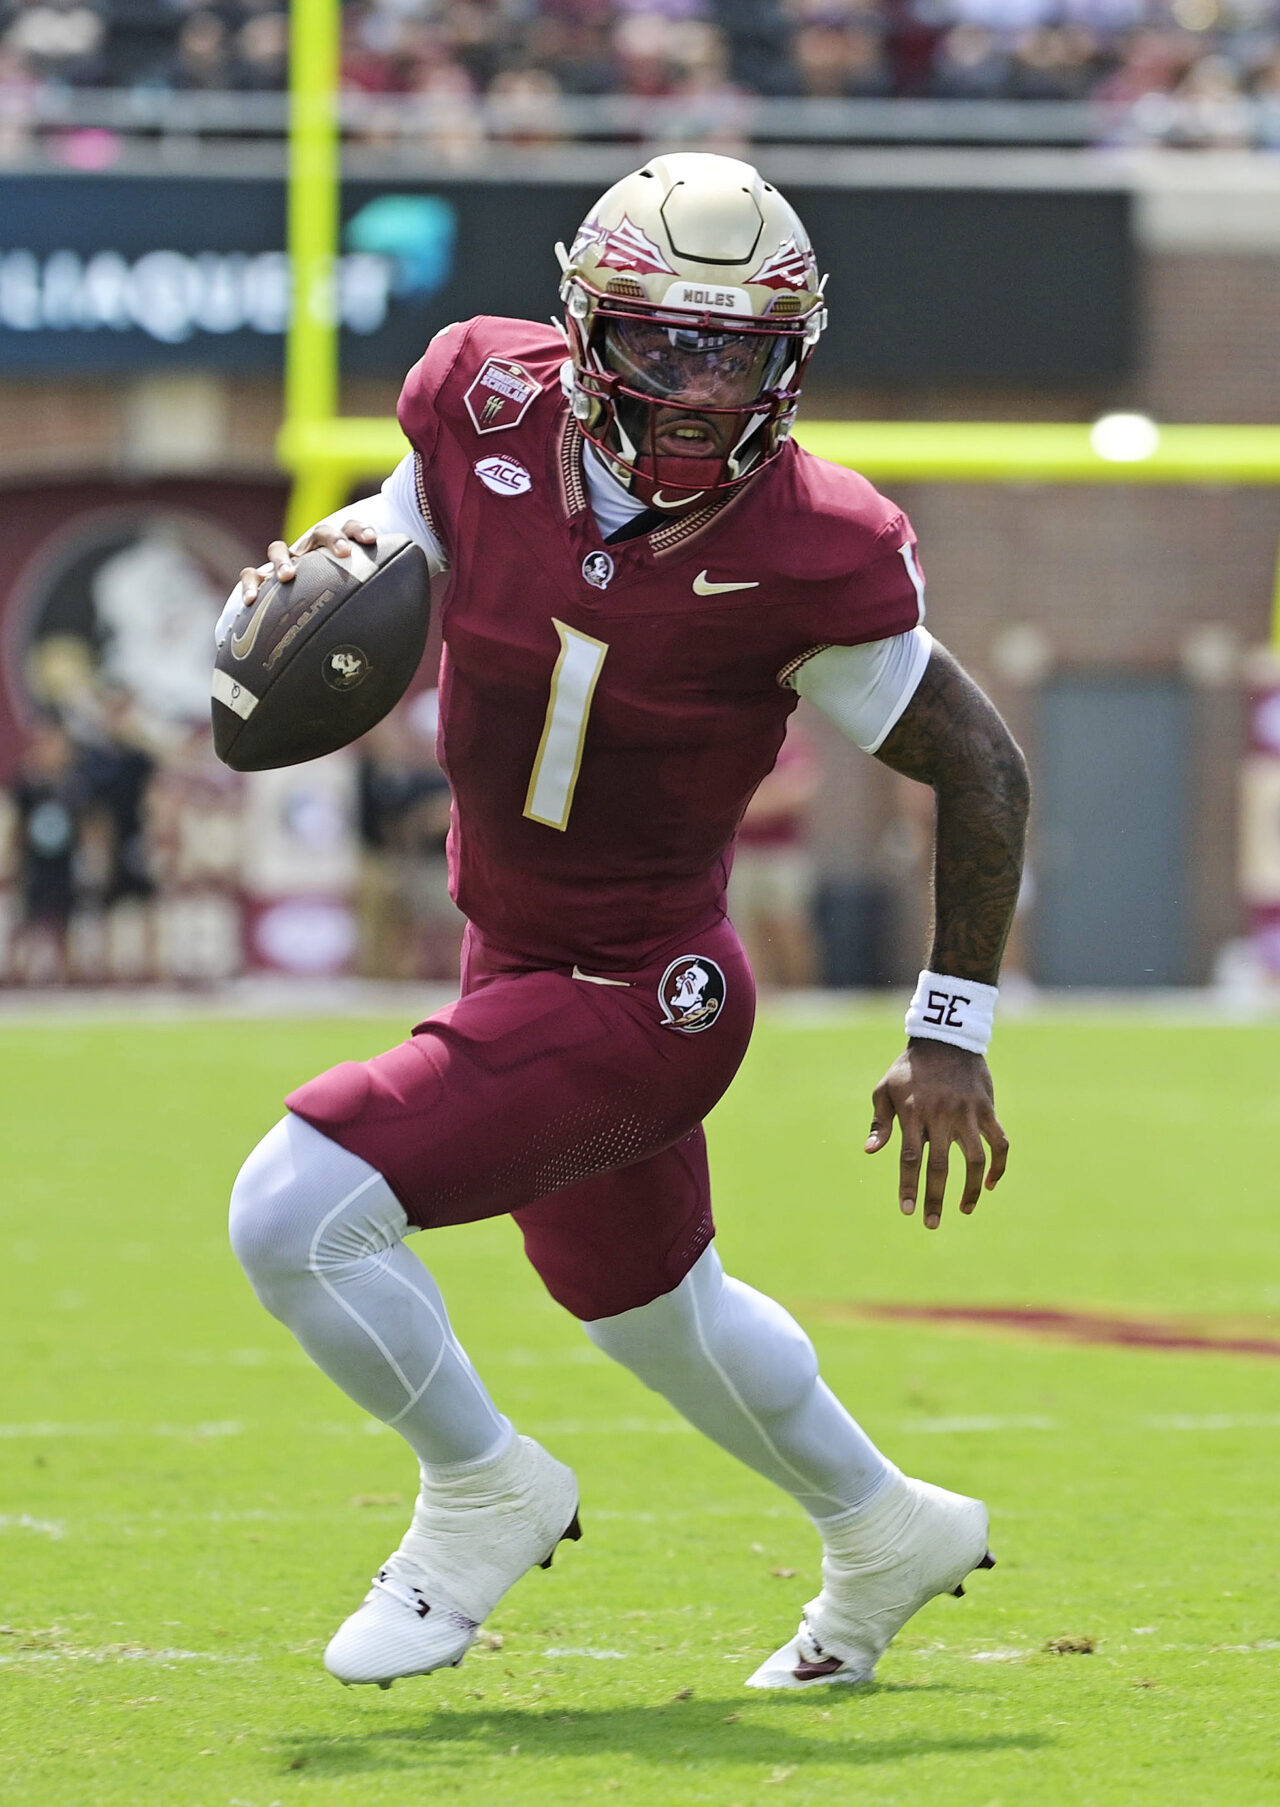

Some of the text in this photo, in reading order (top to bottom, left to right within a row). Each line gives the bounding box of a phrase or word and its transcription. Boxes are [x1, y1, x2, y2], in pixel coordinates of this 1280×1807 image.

[683, 288, 735, 308] NOLES
[482, 464, 528, 487] ACC
[522, 617, 610, 832] 1
